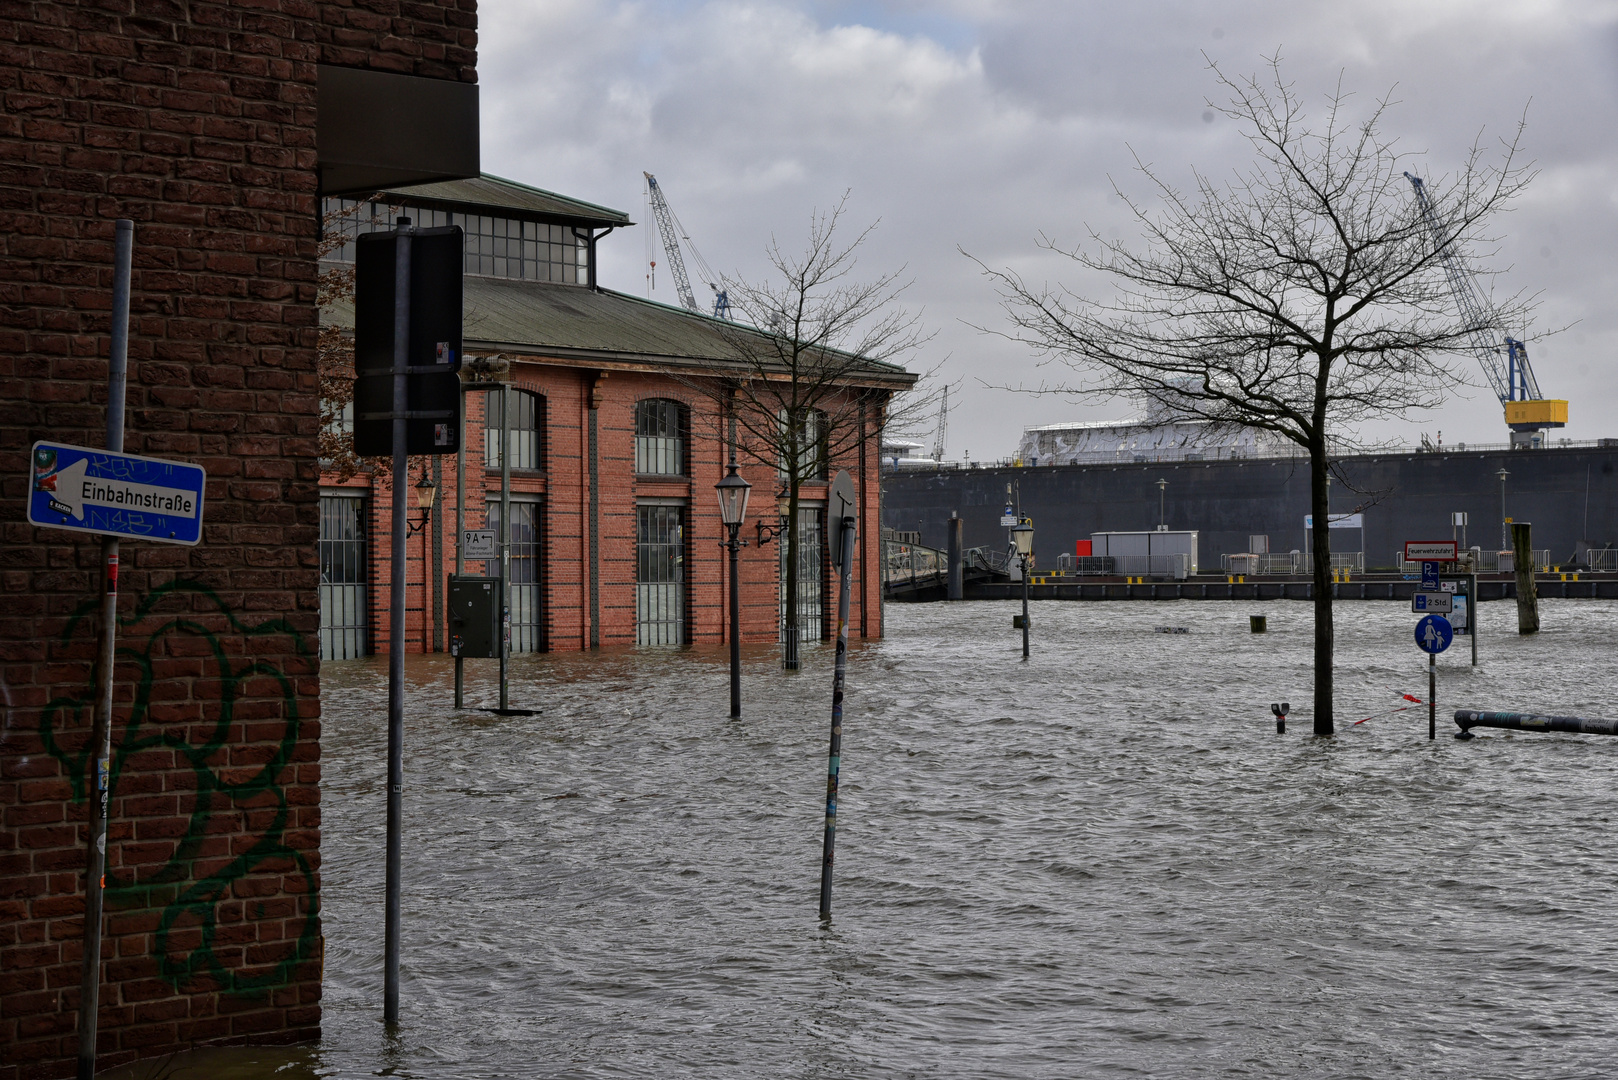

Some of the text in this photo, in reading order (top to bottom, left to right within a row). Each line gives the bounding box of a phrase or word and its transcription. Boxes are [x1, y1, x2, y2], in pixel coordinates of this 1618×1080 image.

[82, 482, 191, 512] Einbahnstraße
[466, 533, 479, 543] 9 A
[1424, 563, 1432, 574] P
